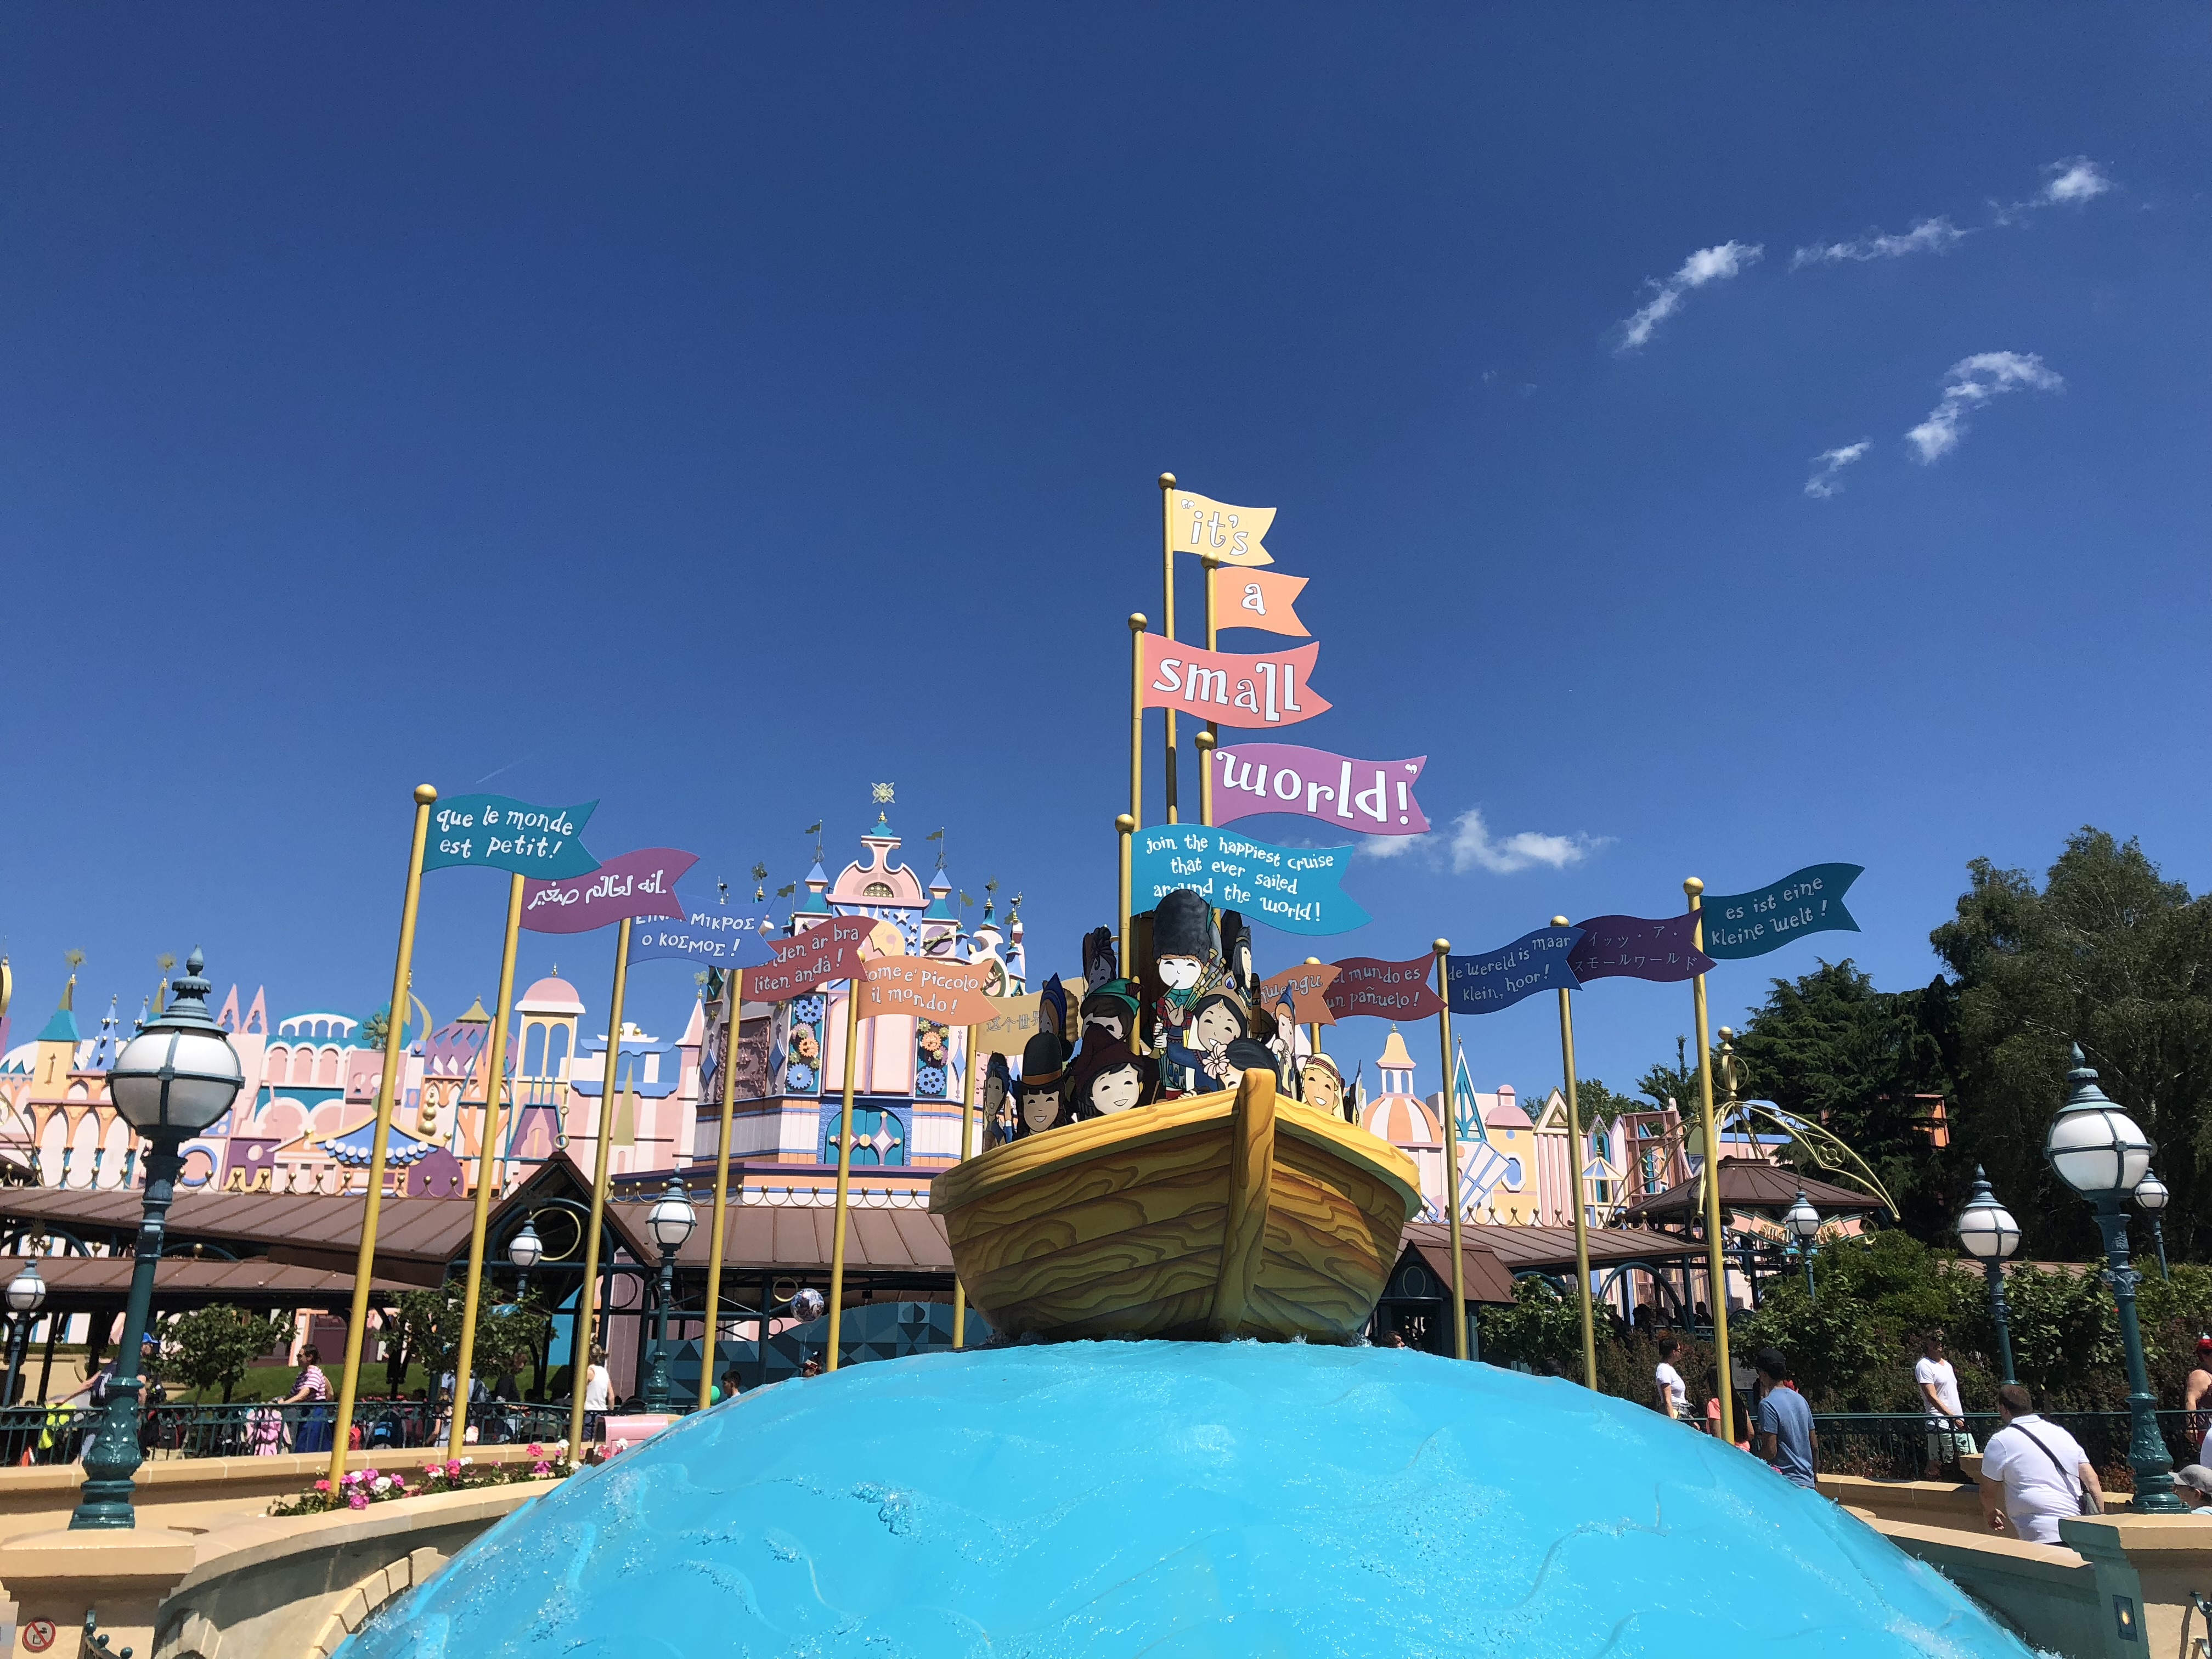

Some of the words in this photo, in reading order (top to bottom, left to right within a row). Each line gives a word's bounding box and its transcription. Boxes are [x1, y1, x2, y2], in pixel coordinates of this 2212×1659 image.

[1241, 583, 1266, 616] a
[1152, 658, 1301, 722] small
[436, 809, 473, 832] que
[482, 805, 499, 826] le
[506, 811, 573, 836] monde
[439, 838, 472, 859] est
[486, 834, 562, 859] petit!
[1147, 837, 1177, 854] join
[1184, 834, 1209, 852] the
[1219, 837, 1281, 867] happiest
[1287, 853, 1334, 871] cruise
[1170, 856, 1203, 876] that
[1212, 861, 1245, 878] ever
[1255, 874, 1297, 895] sailed
[527, 881, 579, 911] صغير
[1224, 883, 1251, 904] the
[1726, 906, 1744, 919] es
[1753, 894, 1776, 913] ist
[1784, 878, 1824, 901] eine
[812, 934, 828, 950] är
[834, 924, 859, 941] bra
[1448, 966, 1463, 981] de
[1465, 951, 1516, 976] wereld
[1519, 947, 1530, 961] is
[1532, 937, 1571, 950] maar
[1573, 952, 1698, 973] スモールワールド
[755, 976, 791, 994] liten
[867, 967, 902, 980] ome
[1349, 967, 1400, 983] mundo
[1404, 968, 1421, 980] es
[871, 986, 881, 1003] il
[1327, 996, 1345, 1009] un
[1463, 986, 1503, 1001] klein,
